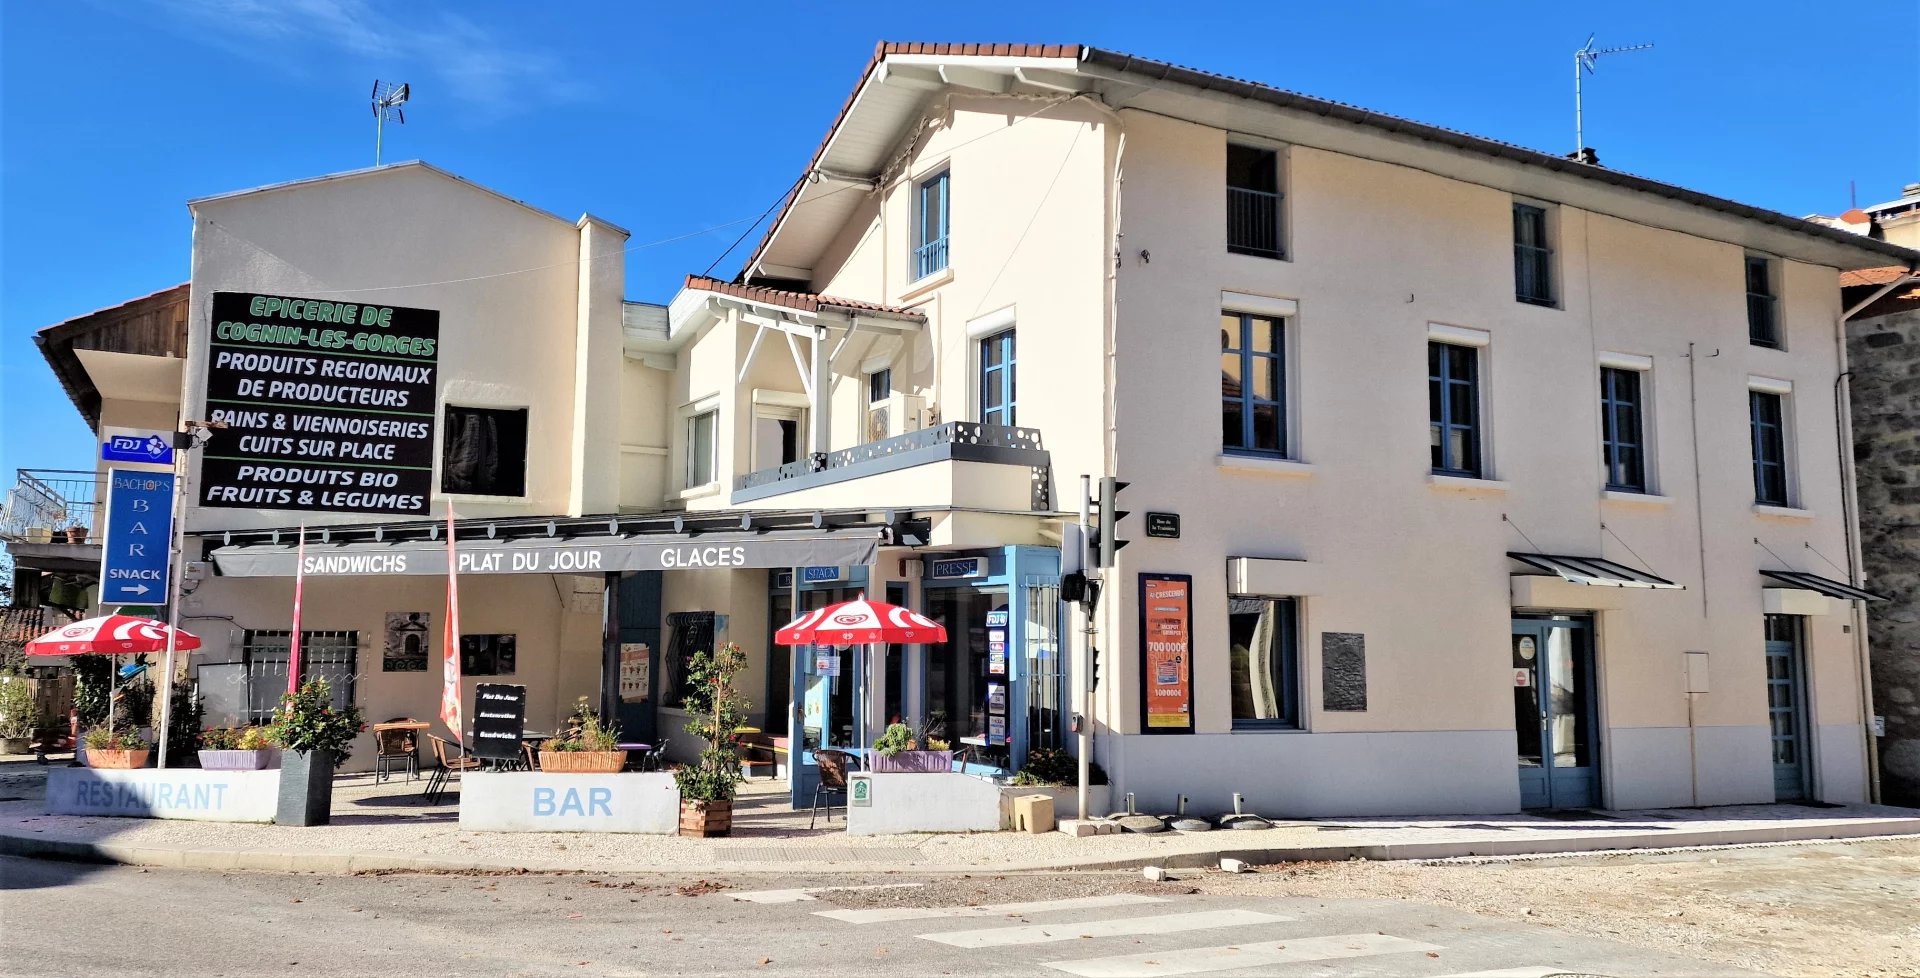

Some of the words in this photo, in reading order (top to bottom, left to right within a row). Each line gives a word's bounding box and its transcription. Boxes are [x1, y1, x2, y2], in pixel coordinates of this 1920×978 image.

[250, 296, 357, 324] EPICERIE
[360, 306, 393, 328] DE
[216, 321, 436, 356] COGNIN-LES-GORGES
[216, 352, 317, 375] PRODUITS
[320, 360, 431, 385] REGIONAUX
[237, 378, 265, 397] DE
[268, 380, 409, 407] PRODUCTEURS
[211, 409, 269, 430] PAINS
[272, 413, 287, 431] &
[292, 415, 429, 439] VIENNOISERIES
[113, 438, 142, 450] FDJ
[239, 435, 294, 455] CUITS
[297, 440, 336, 457] SUR
[339, 442, 396, 460] PLACE
[237, 466, 354, 485] PRODUITS
[359, 472, 399, 488] BIO
[207, 486, 293, 505] FRUITS
[297, 490, 314, 505] &
[320, 491, 424, 510] LEGUMES
[128, 499, 150, 557] BAR
[109, 568, 161, 580] SNACK
[303, 554, 407, 574] SANDWICHS
[458, 553, 504, 572] PLAT
[512, 552, 540, 571] DU
[549, 550, 602, 571] JOUR
[660, 546, 746, 569] GLACES
[936, 561, 976, 575] PRESSE
[76, 780, 228, 810] RESTAURANT
[533, 787, 613, 817] BAR
